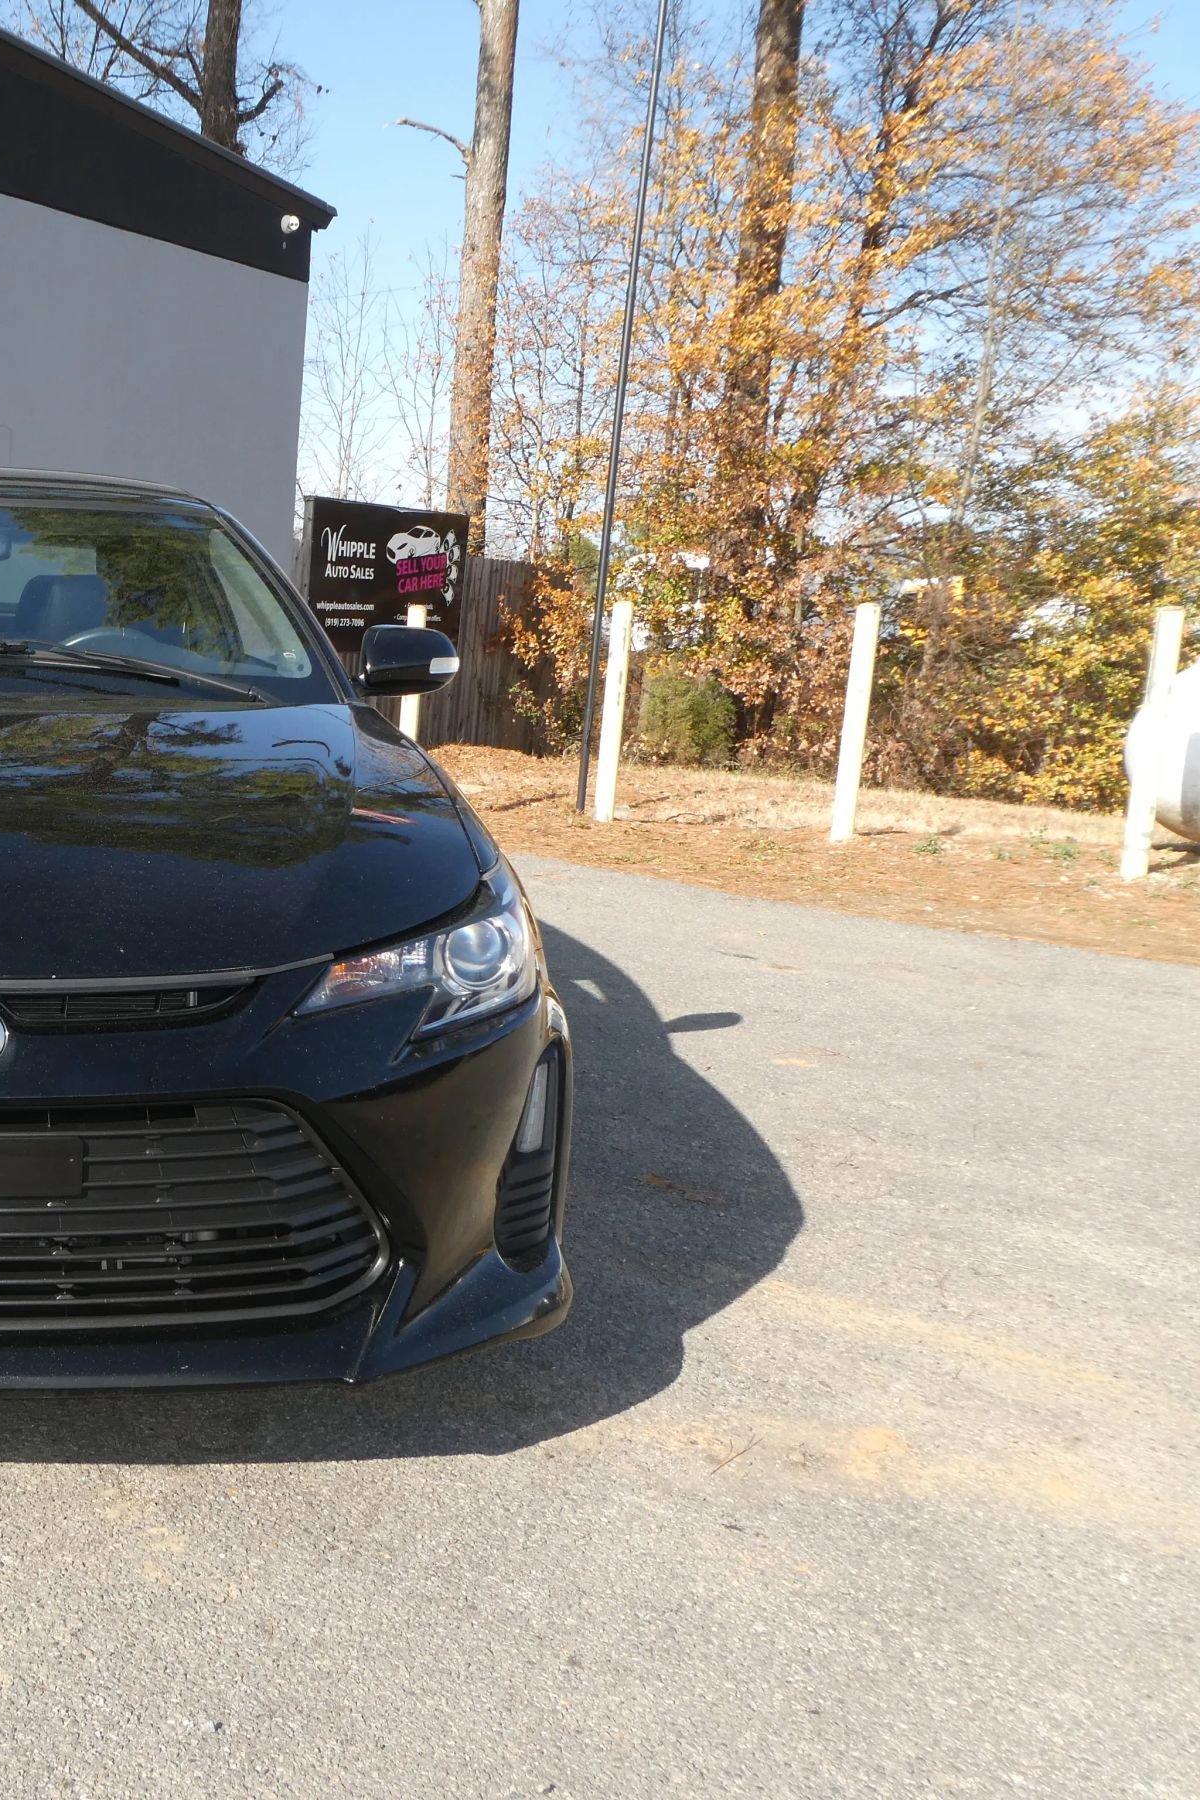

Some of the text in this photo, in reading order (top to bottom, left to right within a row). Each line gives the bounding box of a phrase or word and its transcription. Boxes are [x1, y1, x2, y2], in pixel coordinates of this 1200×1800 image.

[321, 524, 376, 561] WHIPPLE
[325, 563, 374, 580] AUTO SALES
[396, 554, 447, 576] SELL YOUR
[398, 572, 445, 593] CAR HERE
[316, 600, 375, 612] whippleautosales.com
[325, 617, 340, 627] (919)
